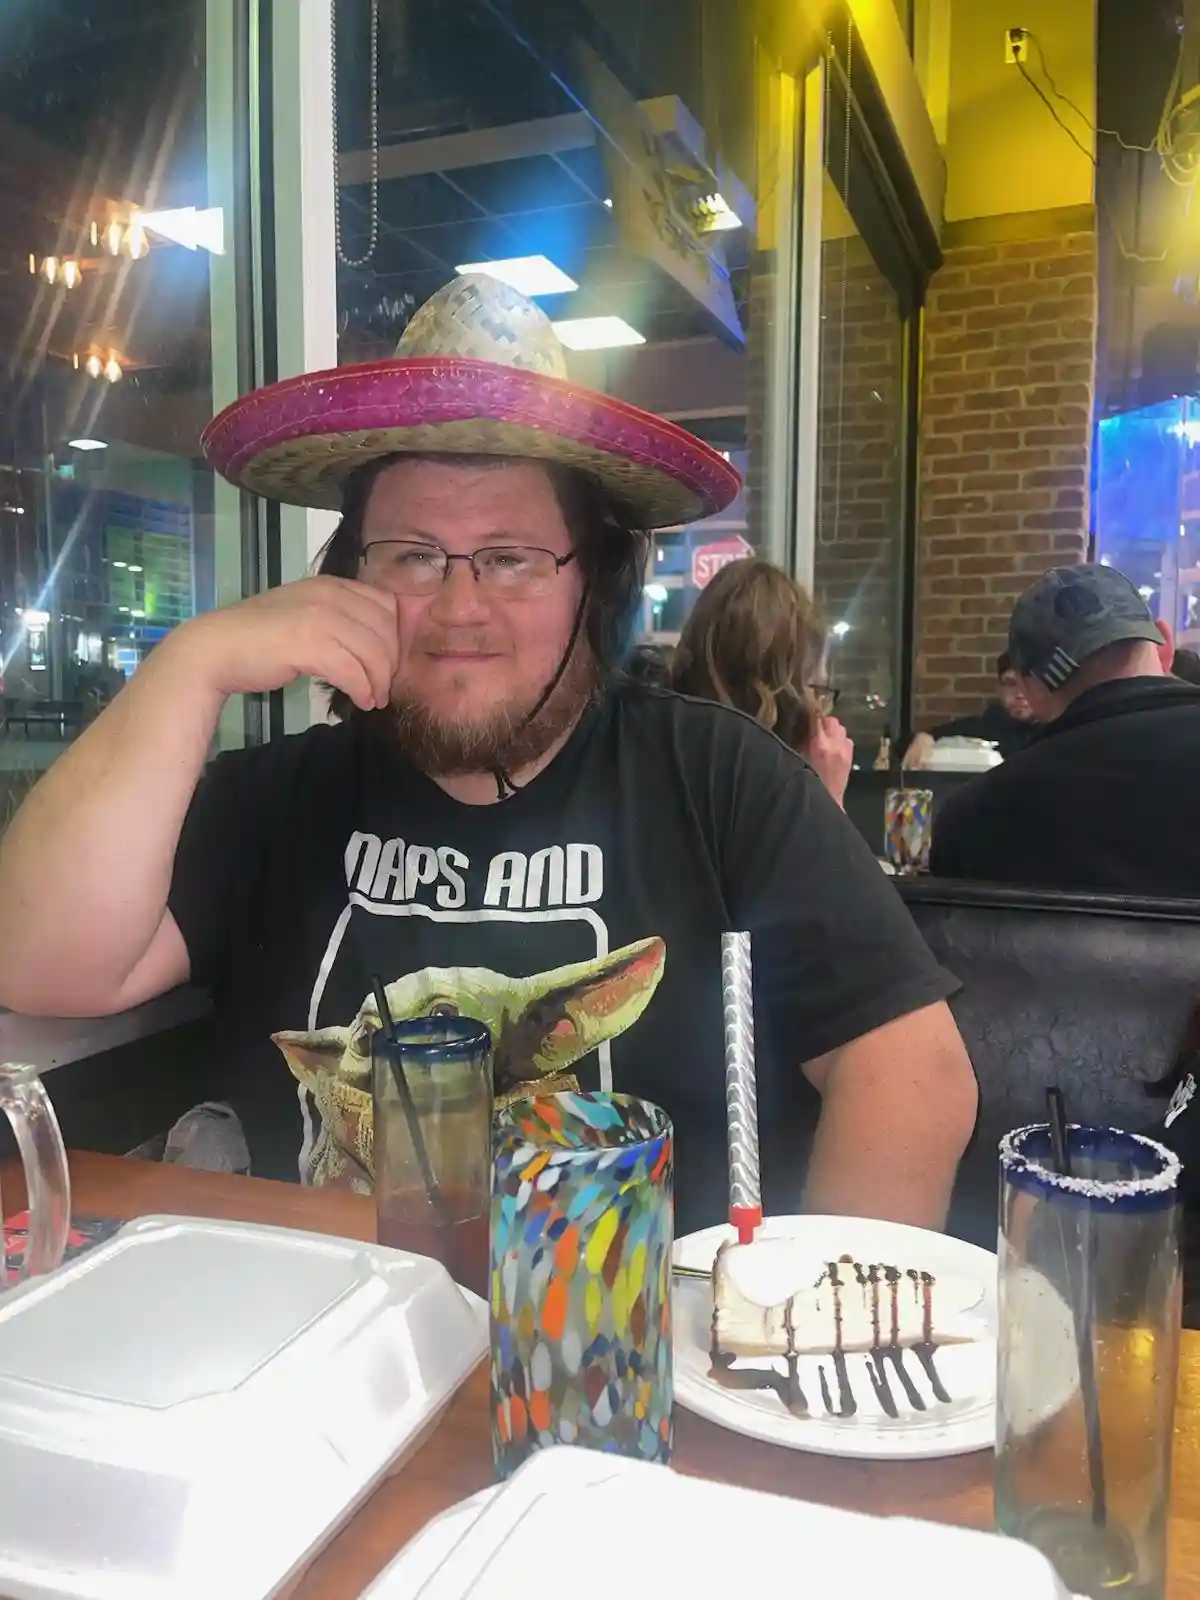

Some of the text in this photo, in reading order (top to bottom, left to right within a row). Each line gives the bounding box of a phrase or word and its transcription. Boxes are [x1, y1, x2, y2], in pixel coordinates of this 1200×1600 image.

[698, 553, 748, 578] ST
[344, 830, 604, 909] NAPS AND
